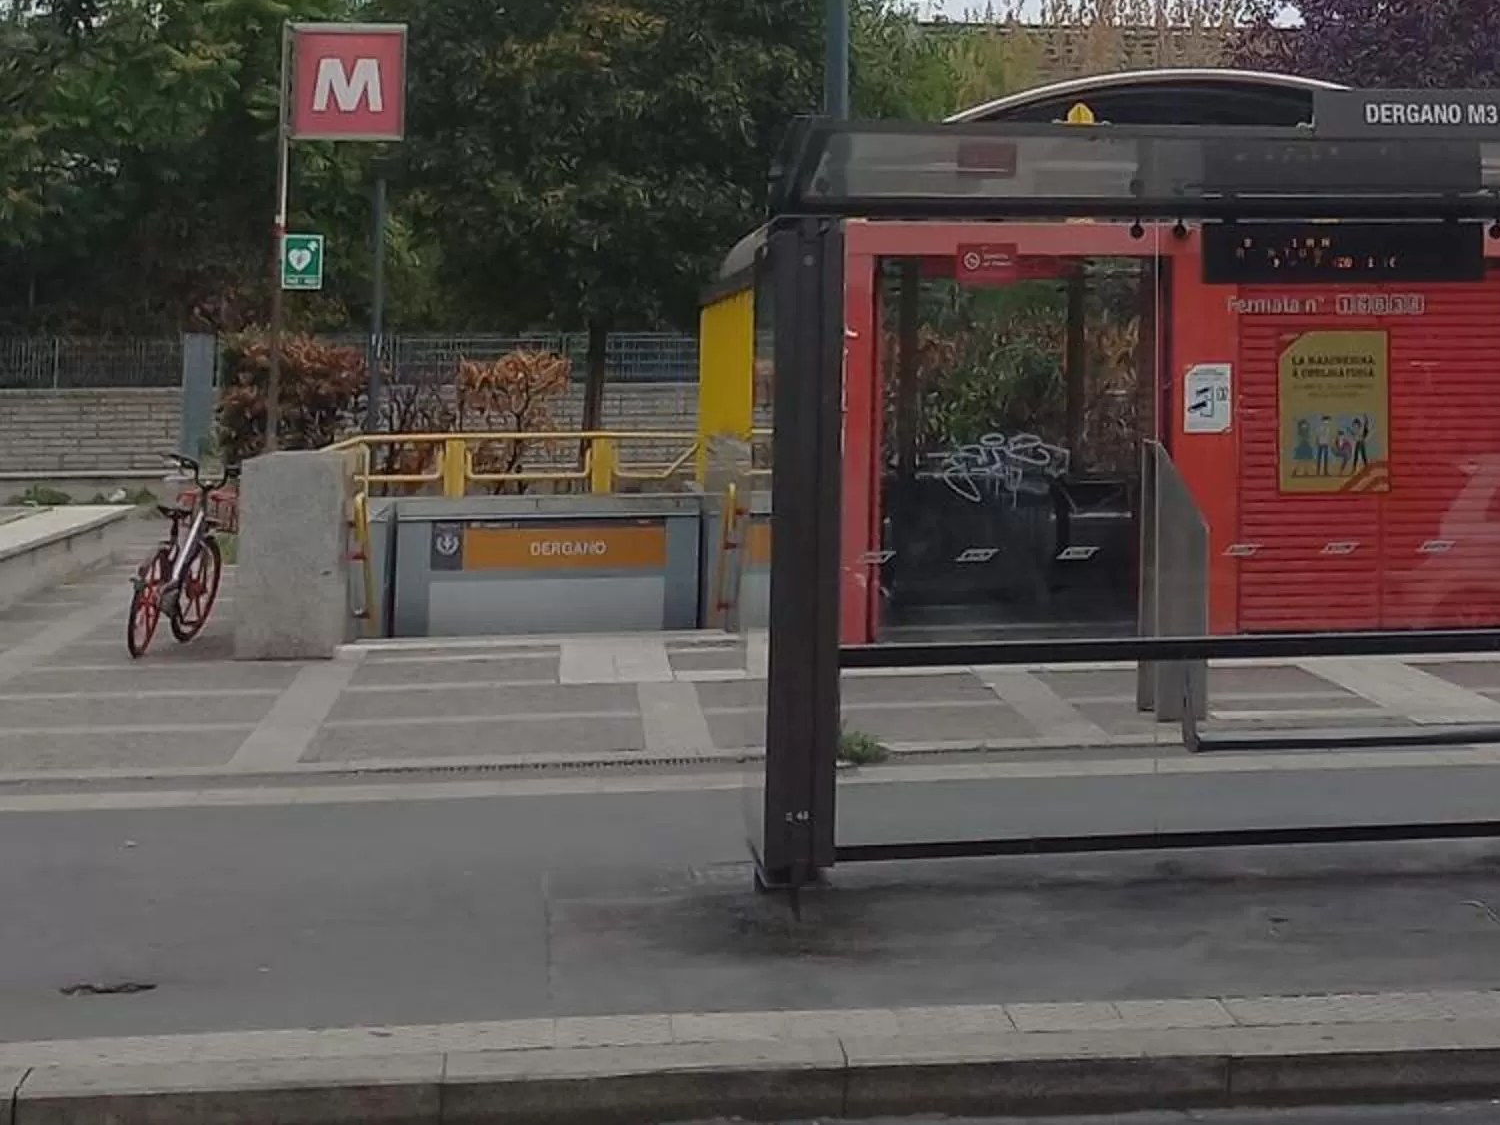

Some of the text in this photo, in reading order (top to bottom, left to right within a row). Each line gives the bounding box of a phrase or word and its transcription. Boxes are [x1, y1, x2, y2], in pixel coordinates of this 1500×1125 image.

[312, 58, 384, 112] M
[1365, 103, 1499, 124] DERGANO M3
[530, 541, 608, 556] DERGANO
